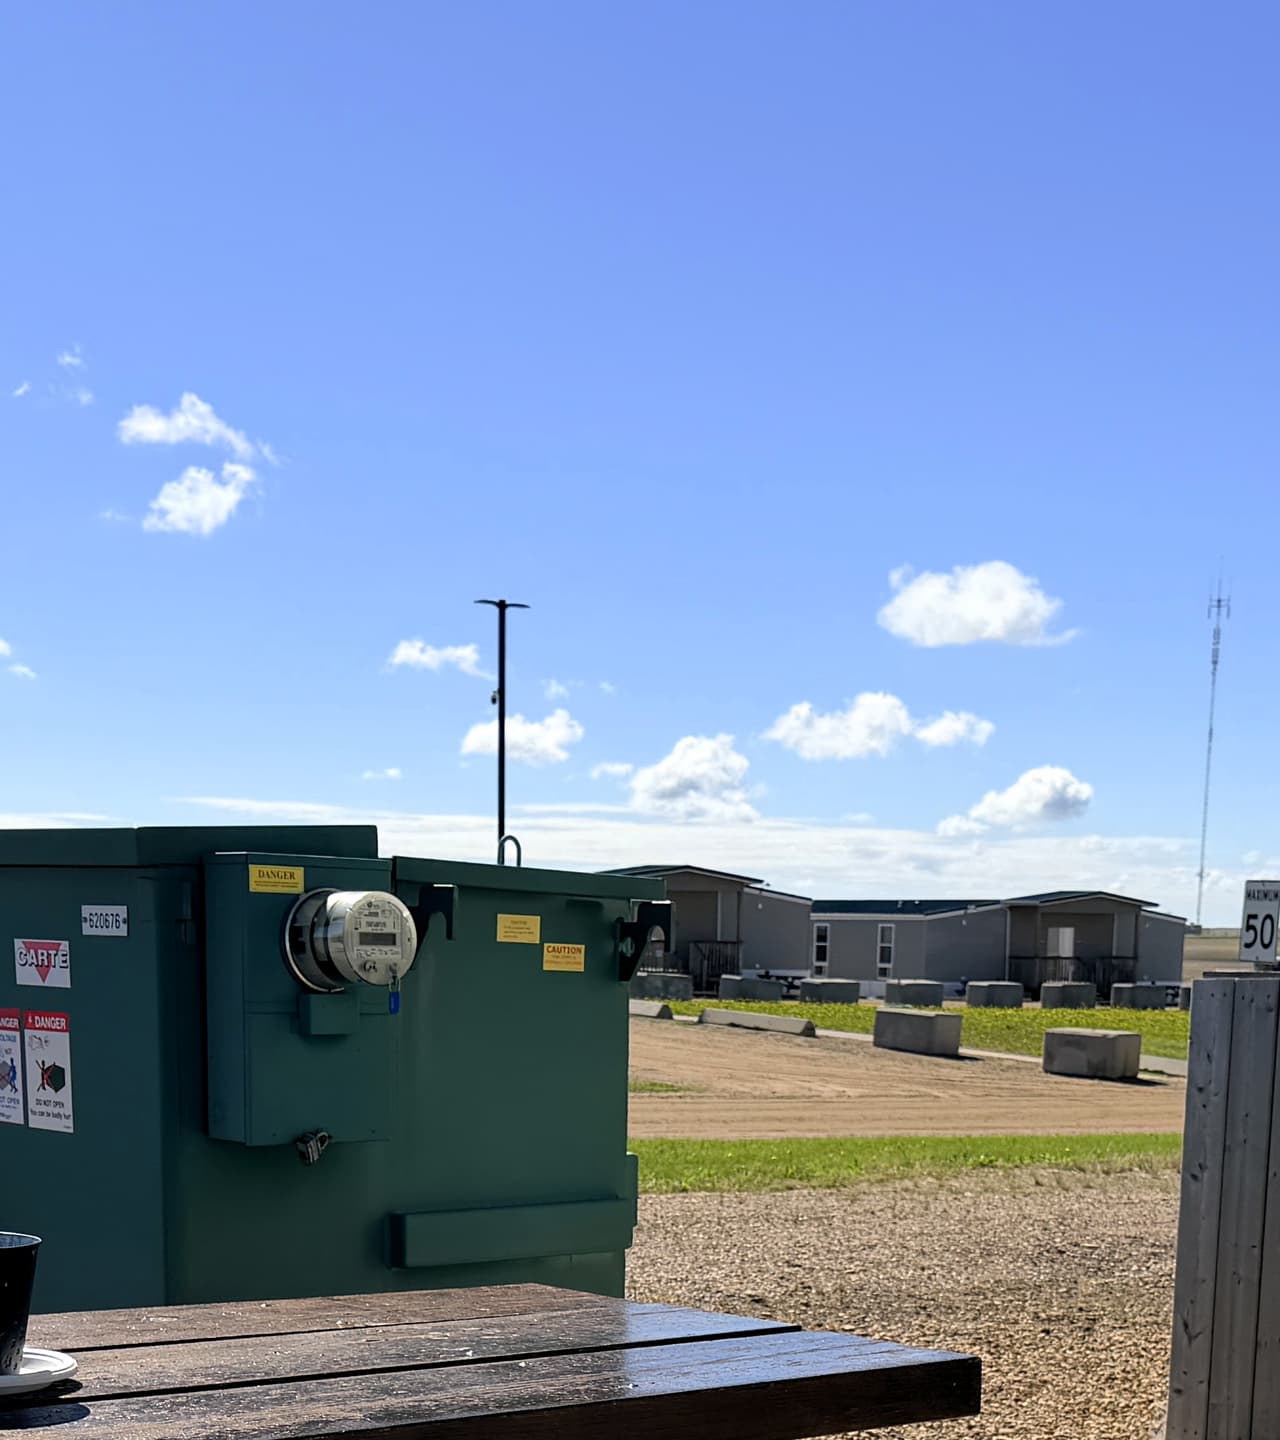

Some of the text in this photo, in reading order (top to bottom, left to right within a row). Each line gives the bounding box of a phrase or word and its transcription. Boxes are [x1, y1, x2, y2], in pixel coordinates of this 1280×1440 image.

[258, 869, 296, 880] DANGER
[1247, 888, 1279, 901] MAXIMUM
[88, 912, 121, 929] 620676
[1244, 913, 1275, 950] 50
[546, 945, 582, 954] CAUTION
[17, 946, 69, 969] CARTE
[34, 1015, 66, 1030] DANGER
[7, 1096, 20, 1105] OPEN
[43, 1099, 52, 1107] NOT
[53, 1100, 64, 1109] OPEN
